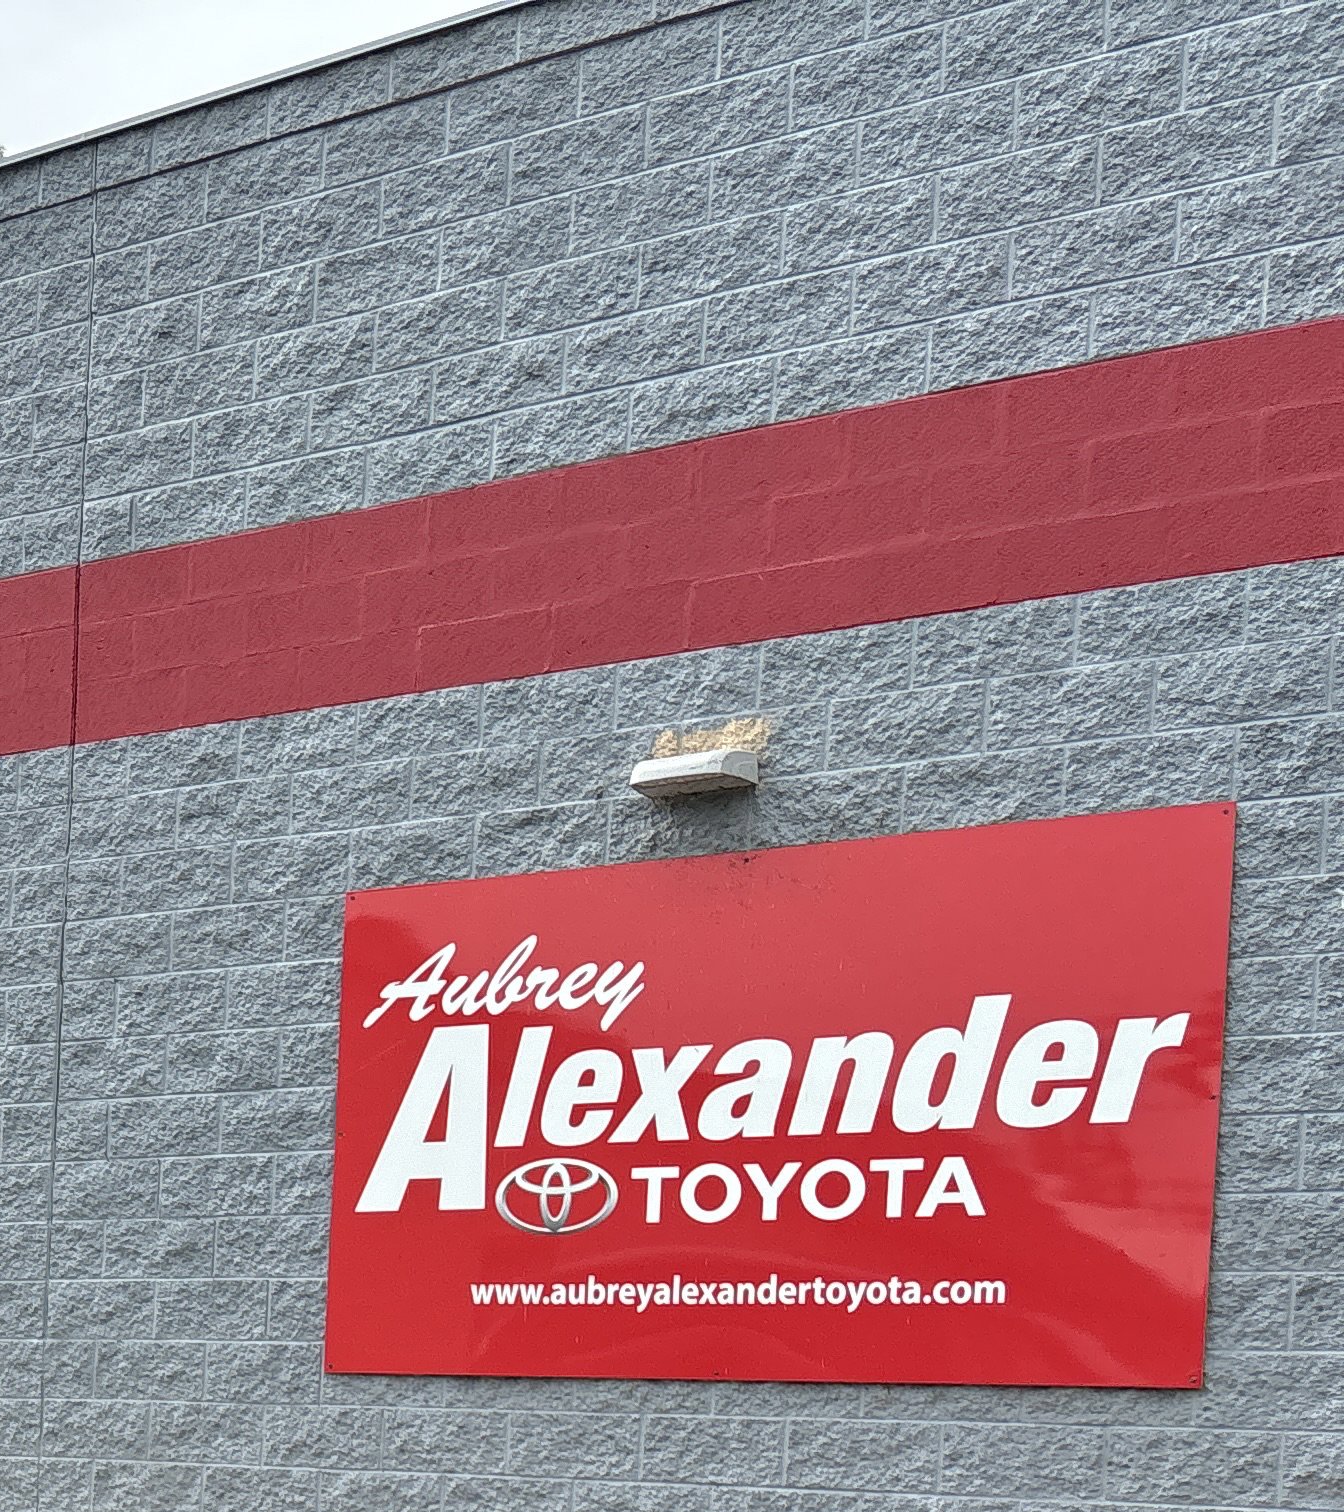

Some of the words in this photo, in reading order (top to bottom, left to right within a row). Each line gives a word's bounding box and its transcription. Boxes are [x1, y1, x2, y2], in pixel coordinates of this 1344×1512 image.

[362, 934, 645, 1032] Aubrey
[354, 993, 1191, 1213] Alexander
[631, 1156, 986, 1224] TOYOTA
[470, 1273, 1006, 1313] www.aubreyalexandertoyota.com
